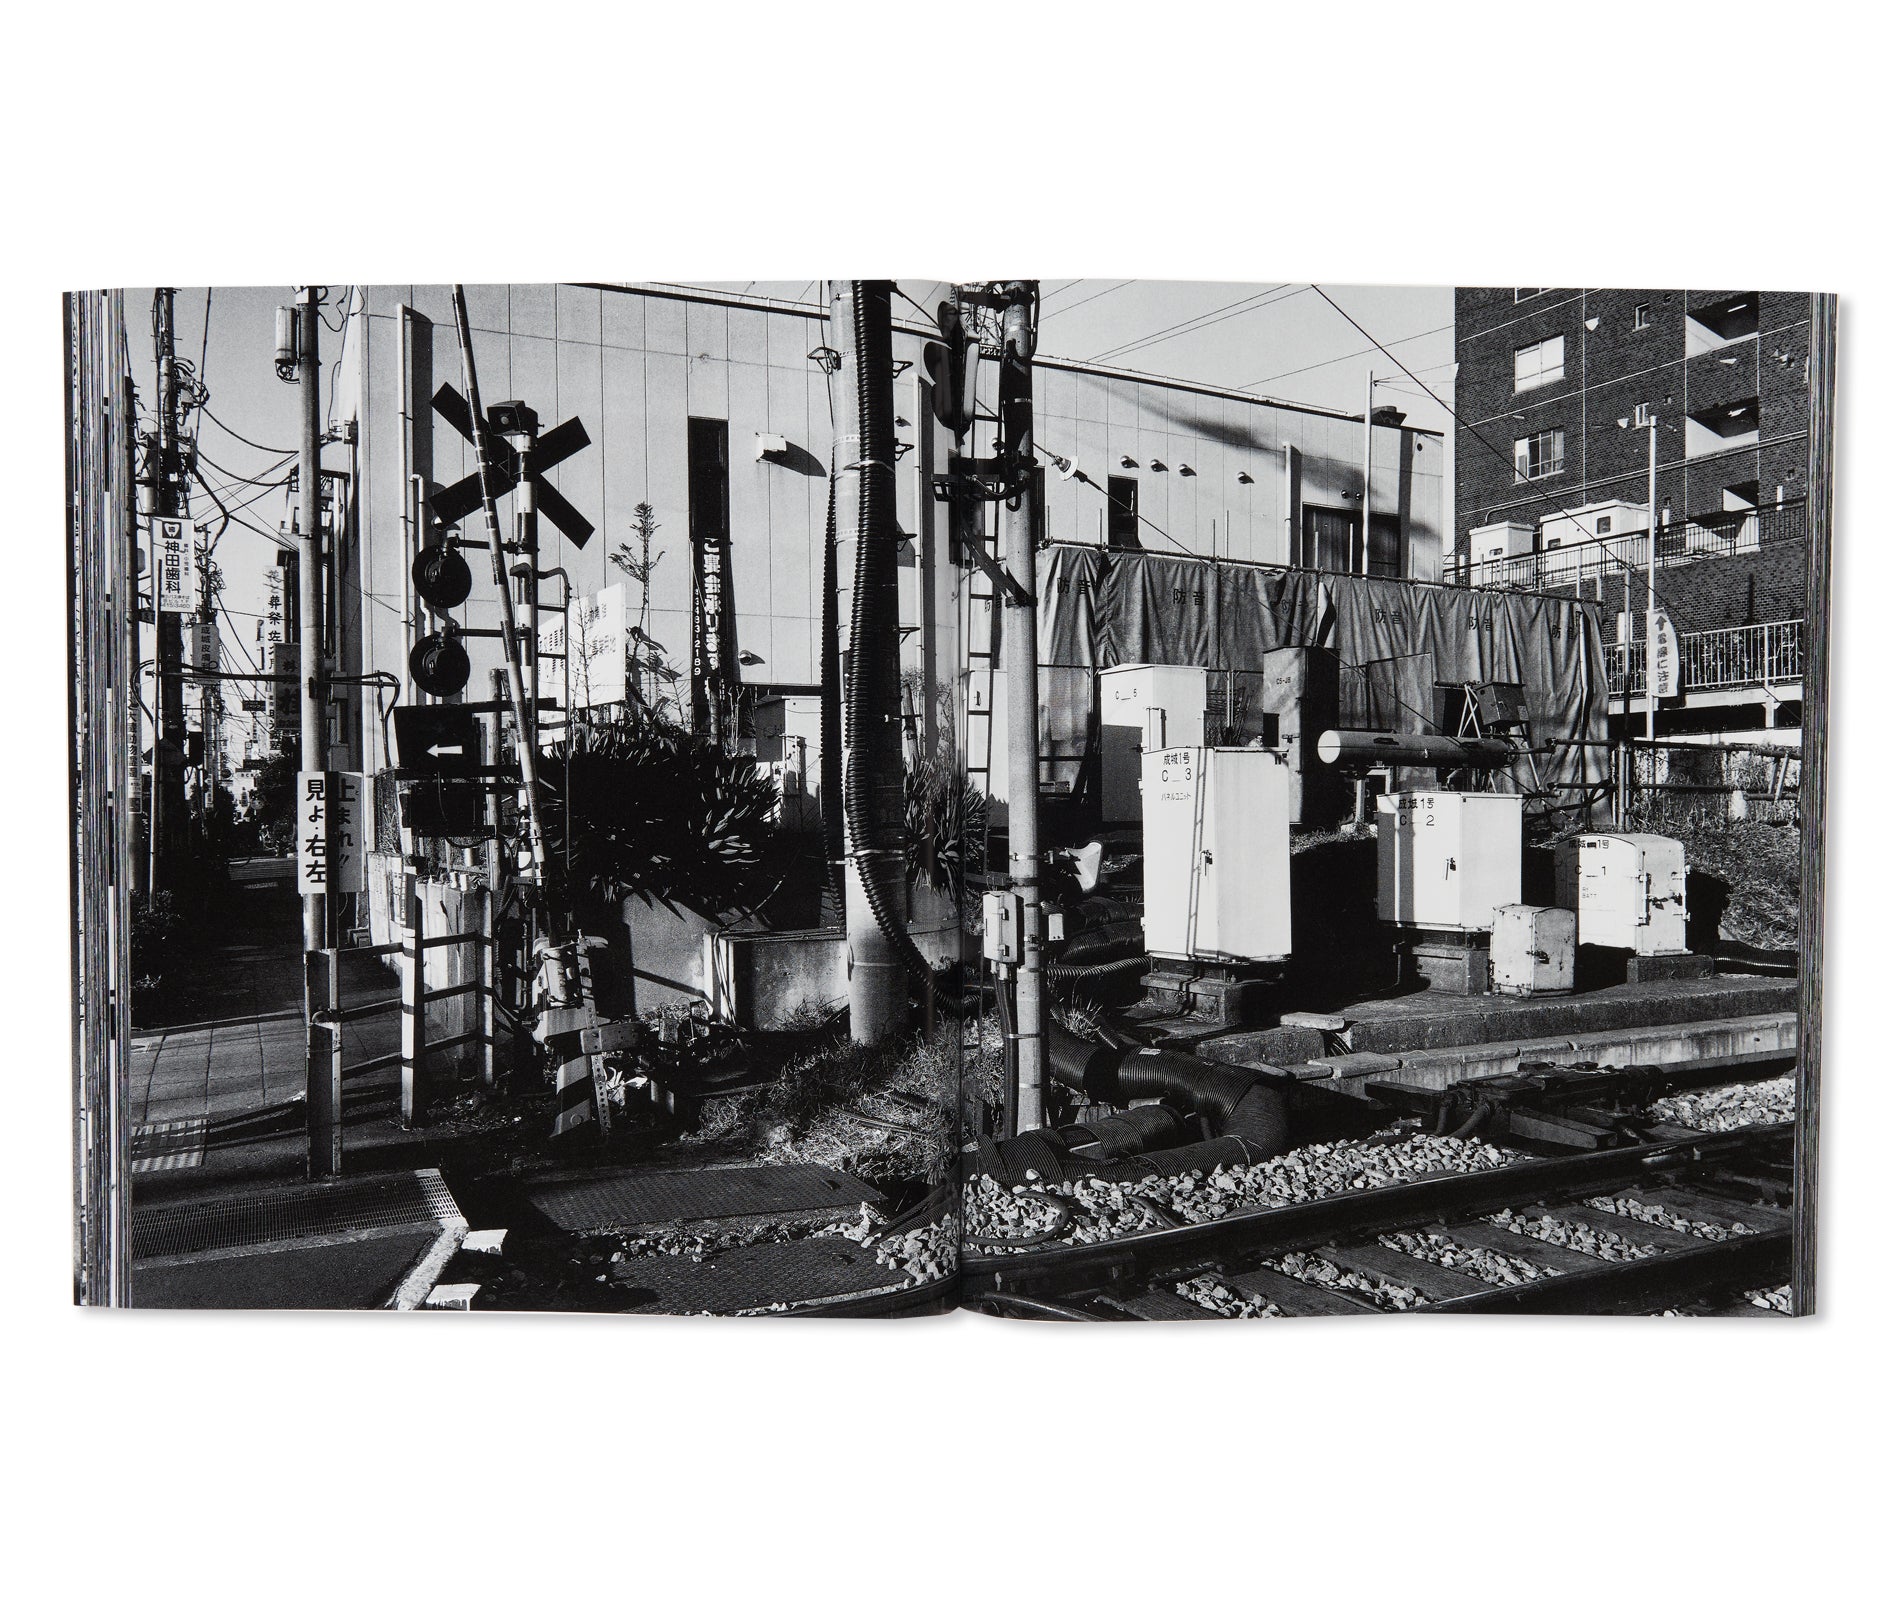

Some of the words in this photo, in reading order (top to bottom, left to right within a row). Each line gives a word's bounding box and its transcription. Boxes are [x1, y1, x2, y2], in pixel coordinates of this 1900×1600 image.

[165, 540, 180, 594] 神田歯科
[1057, 577, 1091, 595] 防音
[1172, 588, 1206, 606] 防音
[1374, 608, 1402, 625] 防音
[1468, 617, 1493, 632] 防音
[1657, 632, 1669, 694] 電線に注意
[1163, 752, 1190, 766] 成城1号
[1398, 797, 1435, 810] 成城1号
